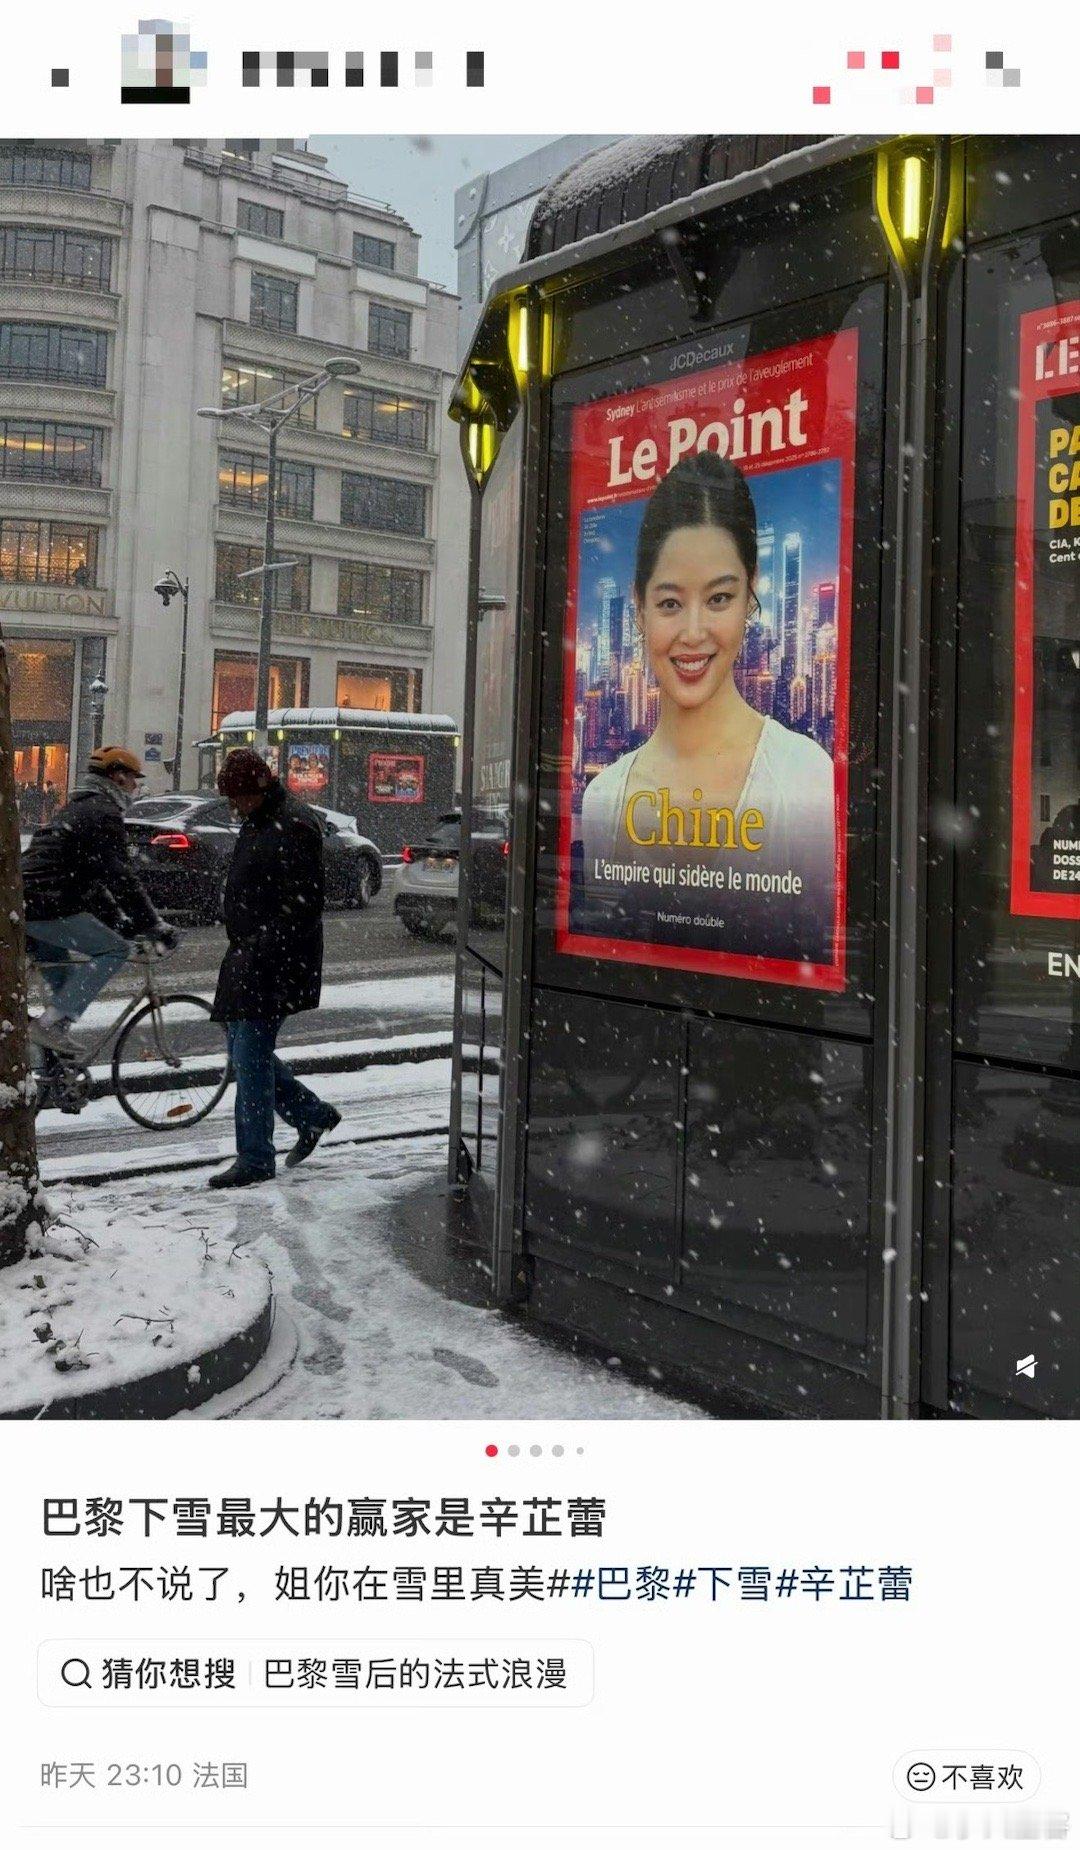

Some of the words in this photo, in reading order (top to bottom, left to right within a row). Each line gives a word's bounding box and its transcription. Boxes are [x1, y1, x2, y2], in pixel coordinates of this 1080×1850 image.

[668, 341, 735, 372] JCDecaux
[606, 403, 635, 422] Sydney
[698, 383, 707, 397] et
[708, 380, 716, 393] le
[717, 374, 734, 393] prix
[735, 371, 748, 386] de
[749, 352, 814, 383] l'aveuglement
[607, 435, 658, 488] Le
[667, 388, 809, 474] Point
[1049, 538, 1072, 550] CIA,
[1049, 551, 1076, 564] Cent
[624, 787, 766, 852] Chine
[1053, 839, 1080, 851] NUM
[594, 858, 650, 885] L'empire
[653, 863, 676, 888] qui
[678, 865, 724, 890] sidère
[728, 867, 742, 890] le
[745, 869, 803, 895] monde
[656, 911, 692, 924] Numéro
[693, 914, 725, 928] double
[1048, 951, 1080, 979] EN
